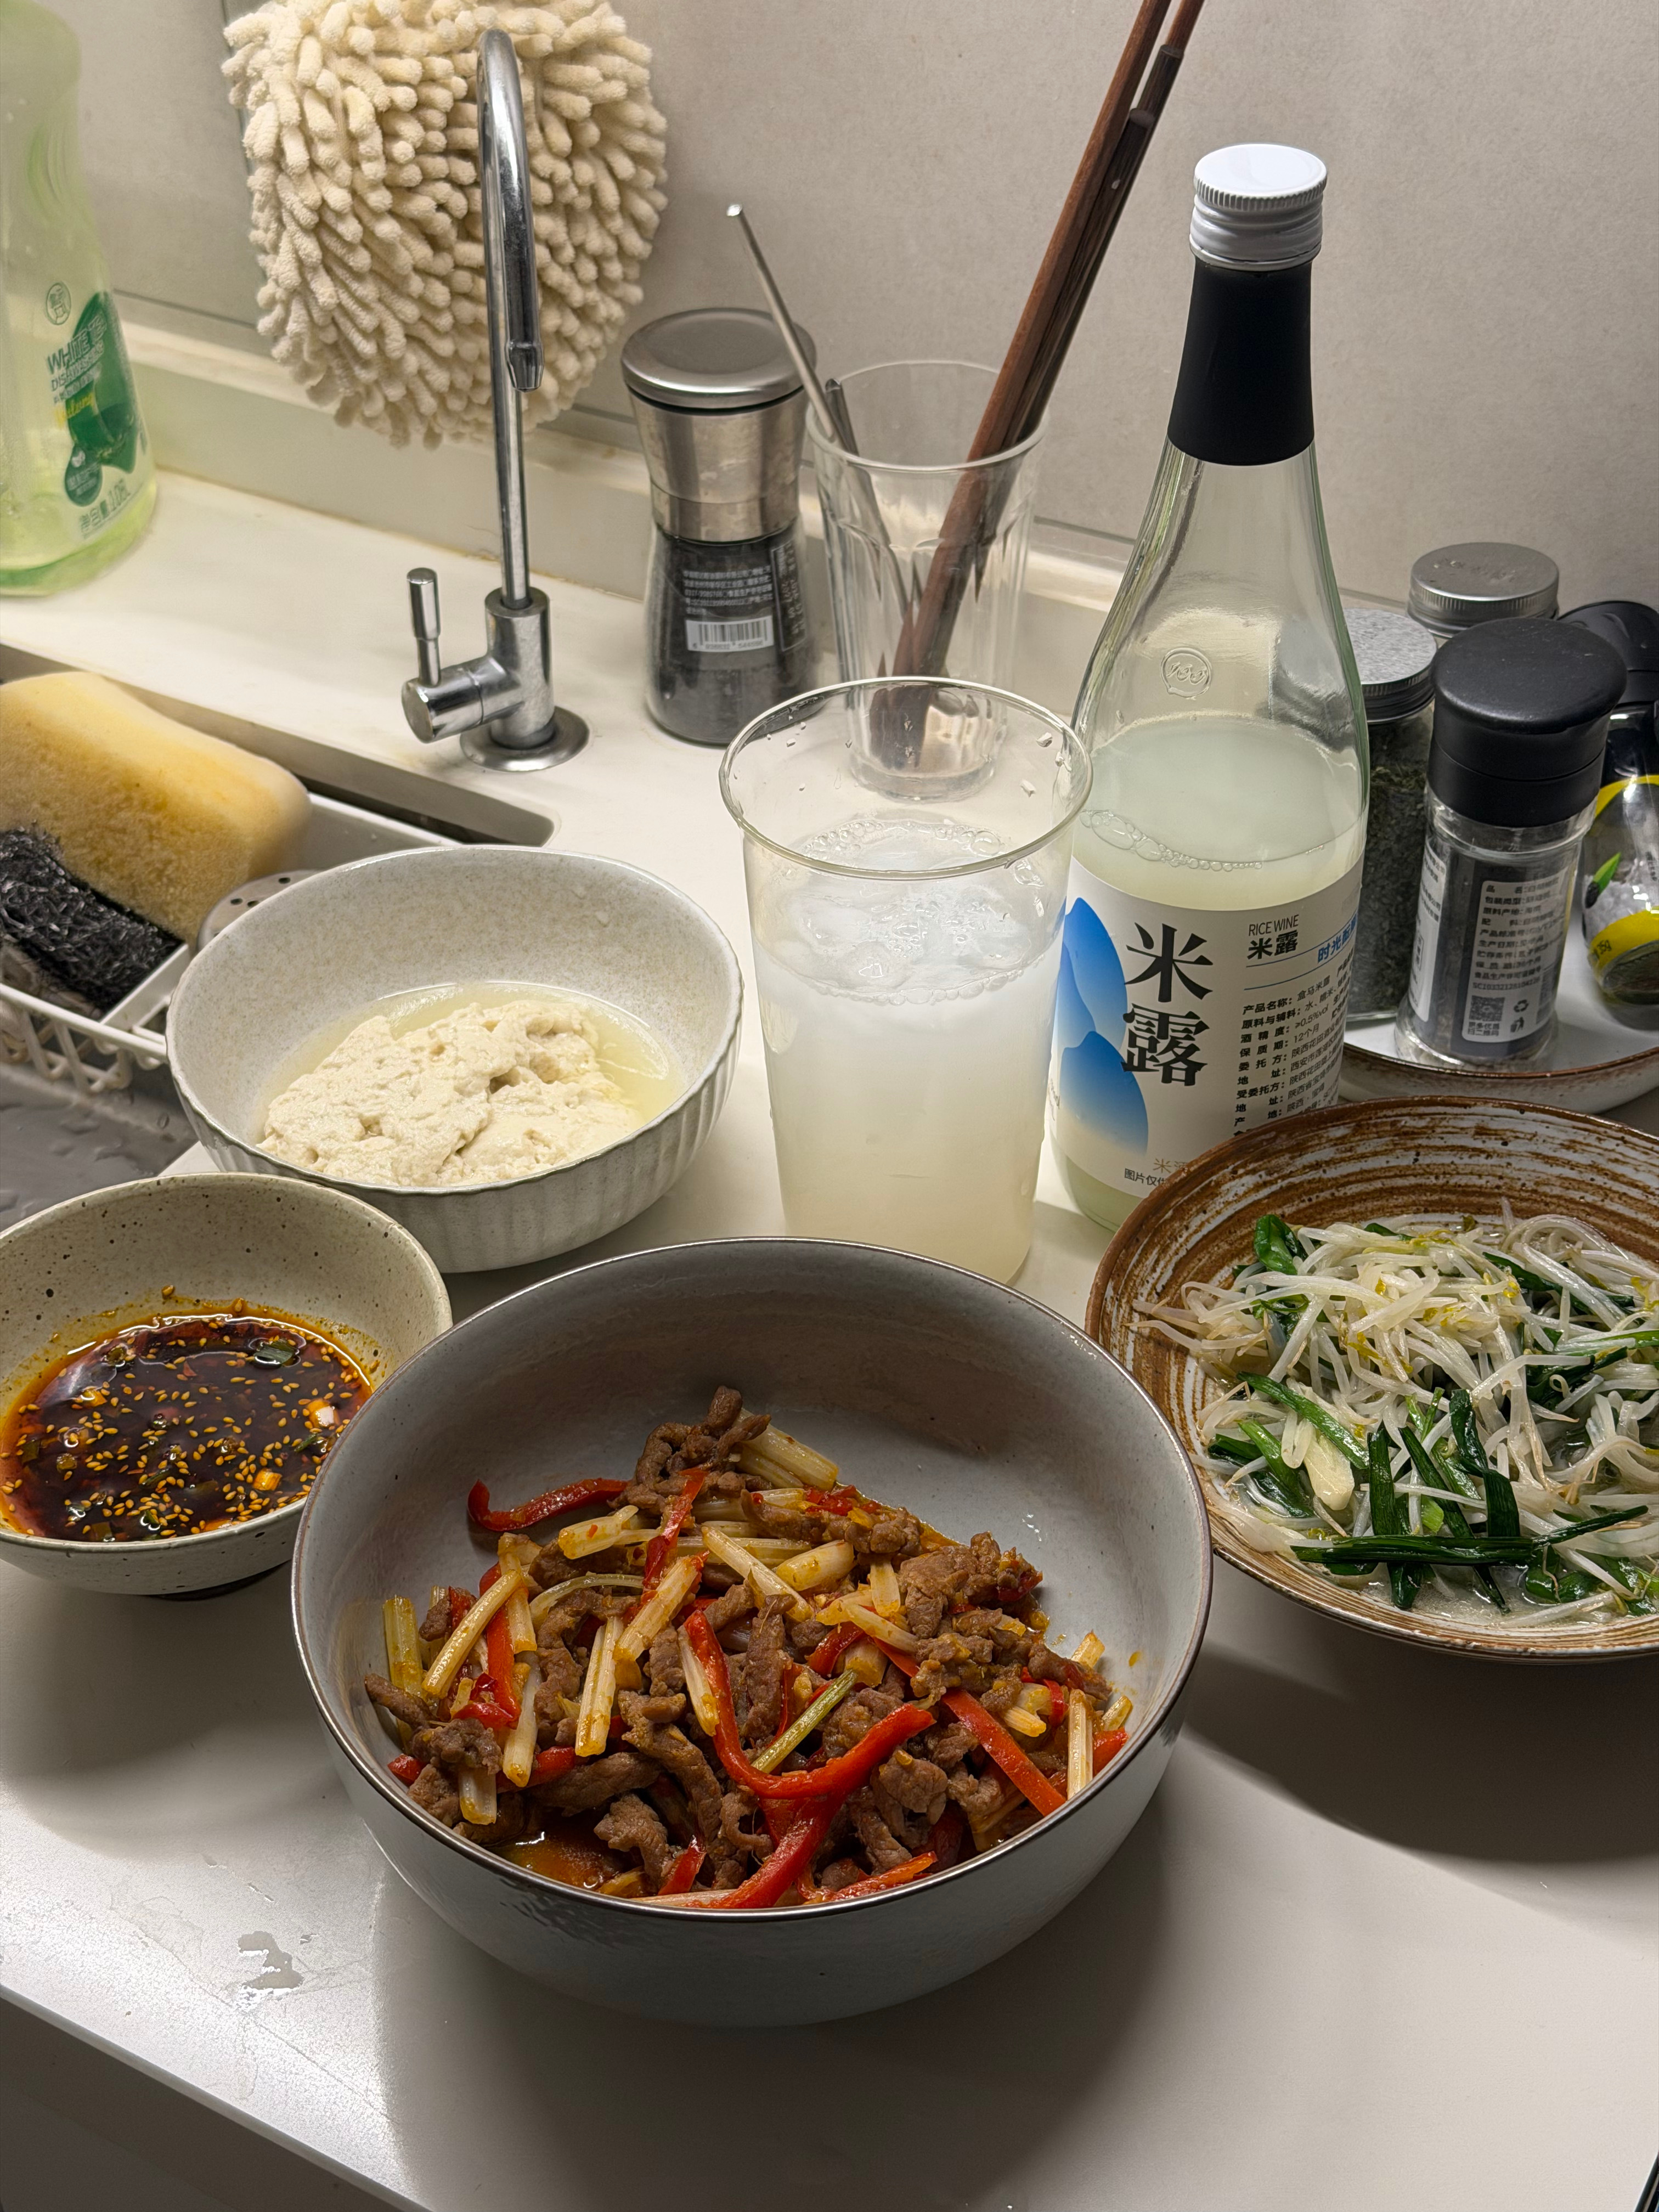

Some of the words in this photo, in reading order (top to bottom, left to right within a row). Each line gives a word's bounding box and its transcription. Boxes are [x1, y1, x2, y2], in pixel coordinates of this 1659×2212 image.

[1249, 921, 1272, 936] RICE
[1273, 914, 1299, 933] WINE
[1247, 929, 1299, 960] 米露
[1121, 922, 1214, 1086] 米露
